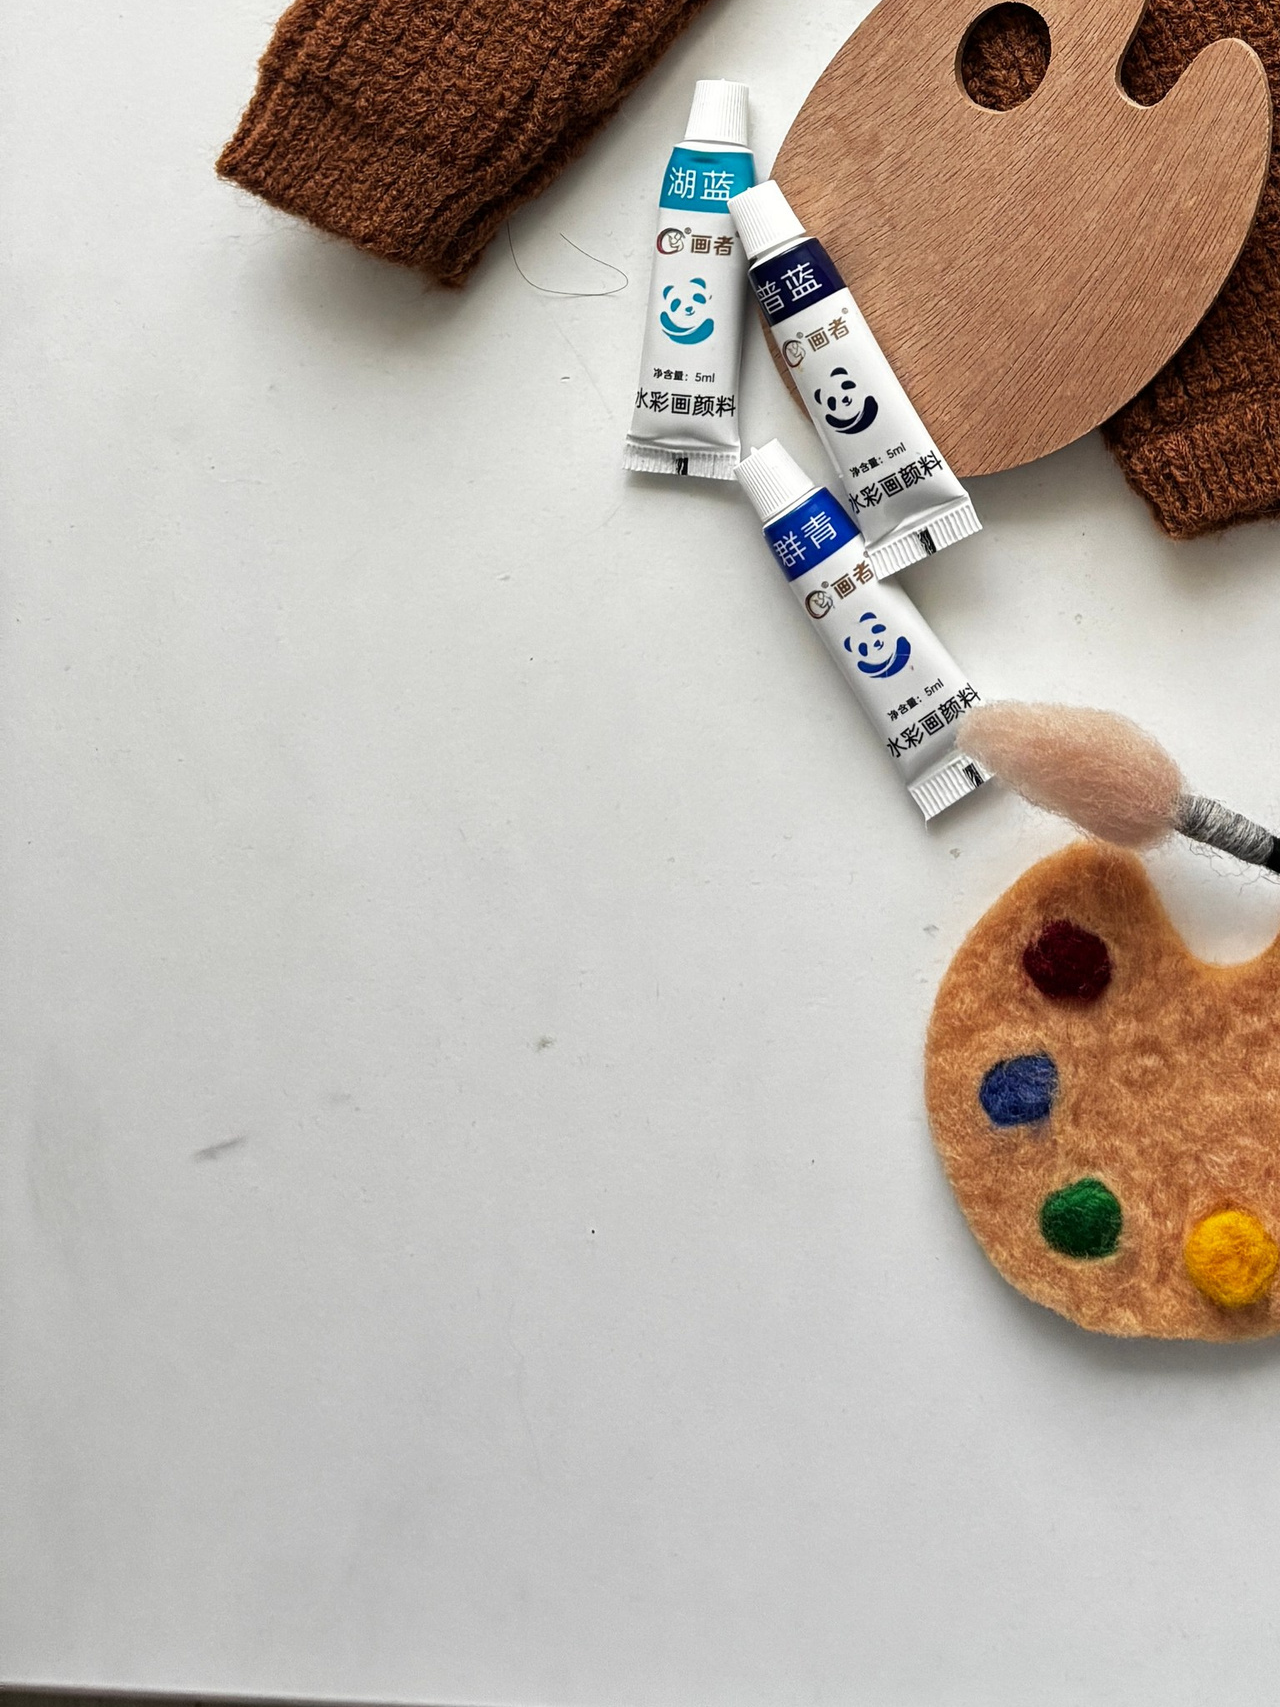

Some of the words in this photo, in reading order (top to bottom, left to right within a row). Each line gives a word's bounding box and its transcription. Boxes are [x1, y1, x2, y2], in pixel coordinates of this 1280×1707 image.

[668, 167, 734, 201] 湖蓝
[691, 234, 734, 256] 画者
[757, 262, 822, 314] 普蓝
[805, 316, 849, 352] 画者
[694, 372, 715, 383] 5ml
[636, 387, 736, 417] 水彩画颜料
[886, 442, 906, 459] 5ml
[848, 450, 943, 514] 水彩画颜料
[773, 511, 837, 567] 群青
[831, 560, 874, 599] 画者
[924, 678, 944, 697] 5ml
[887, 682, 981, 758] 水彩画颜料
